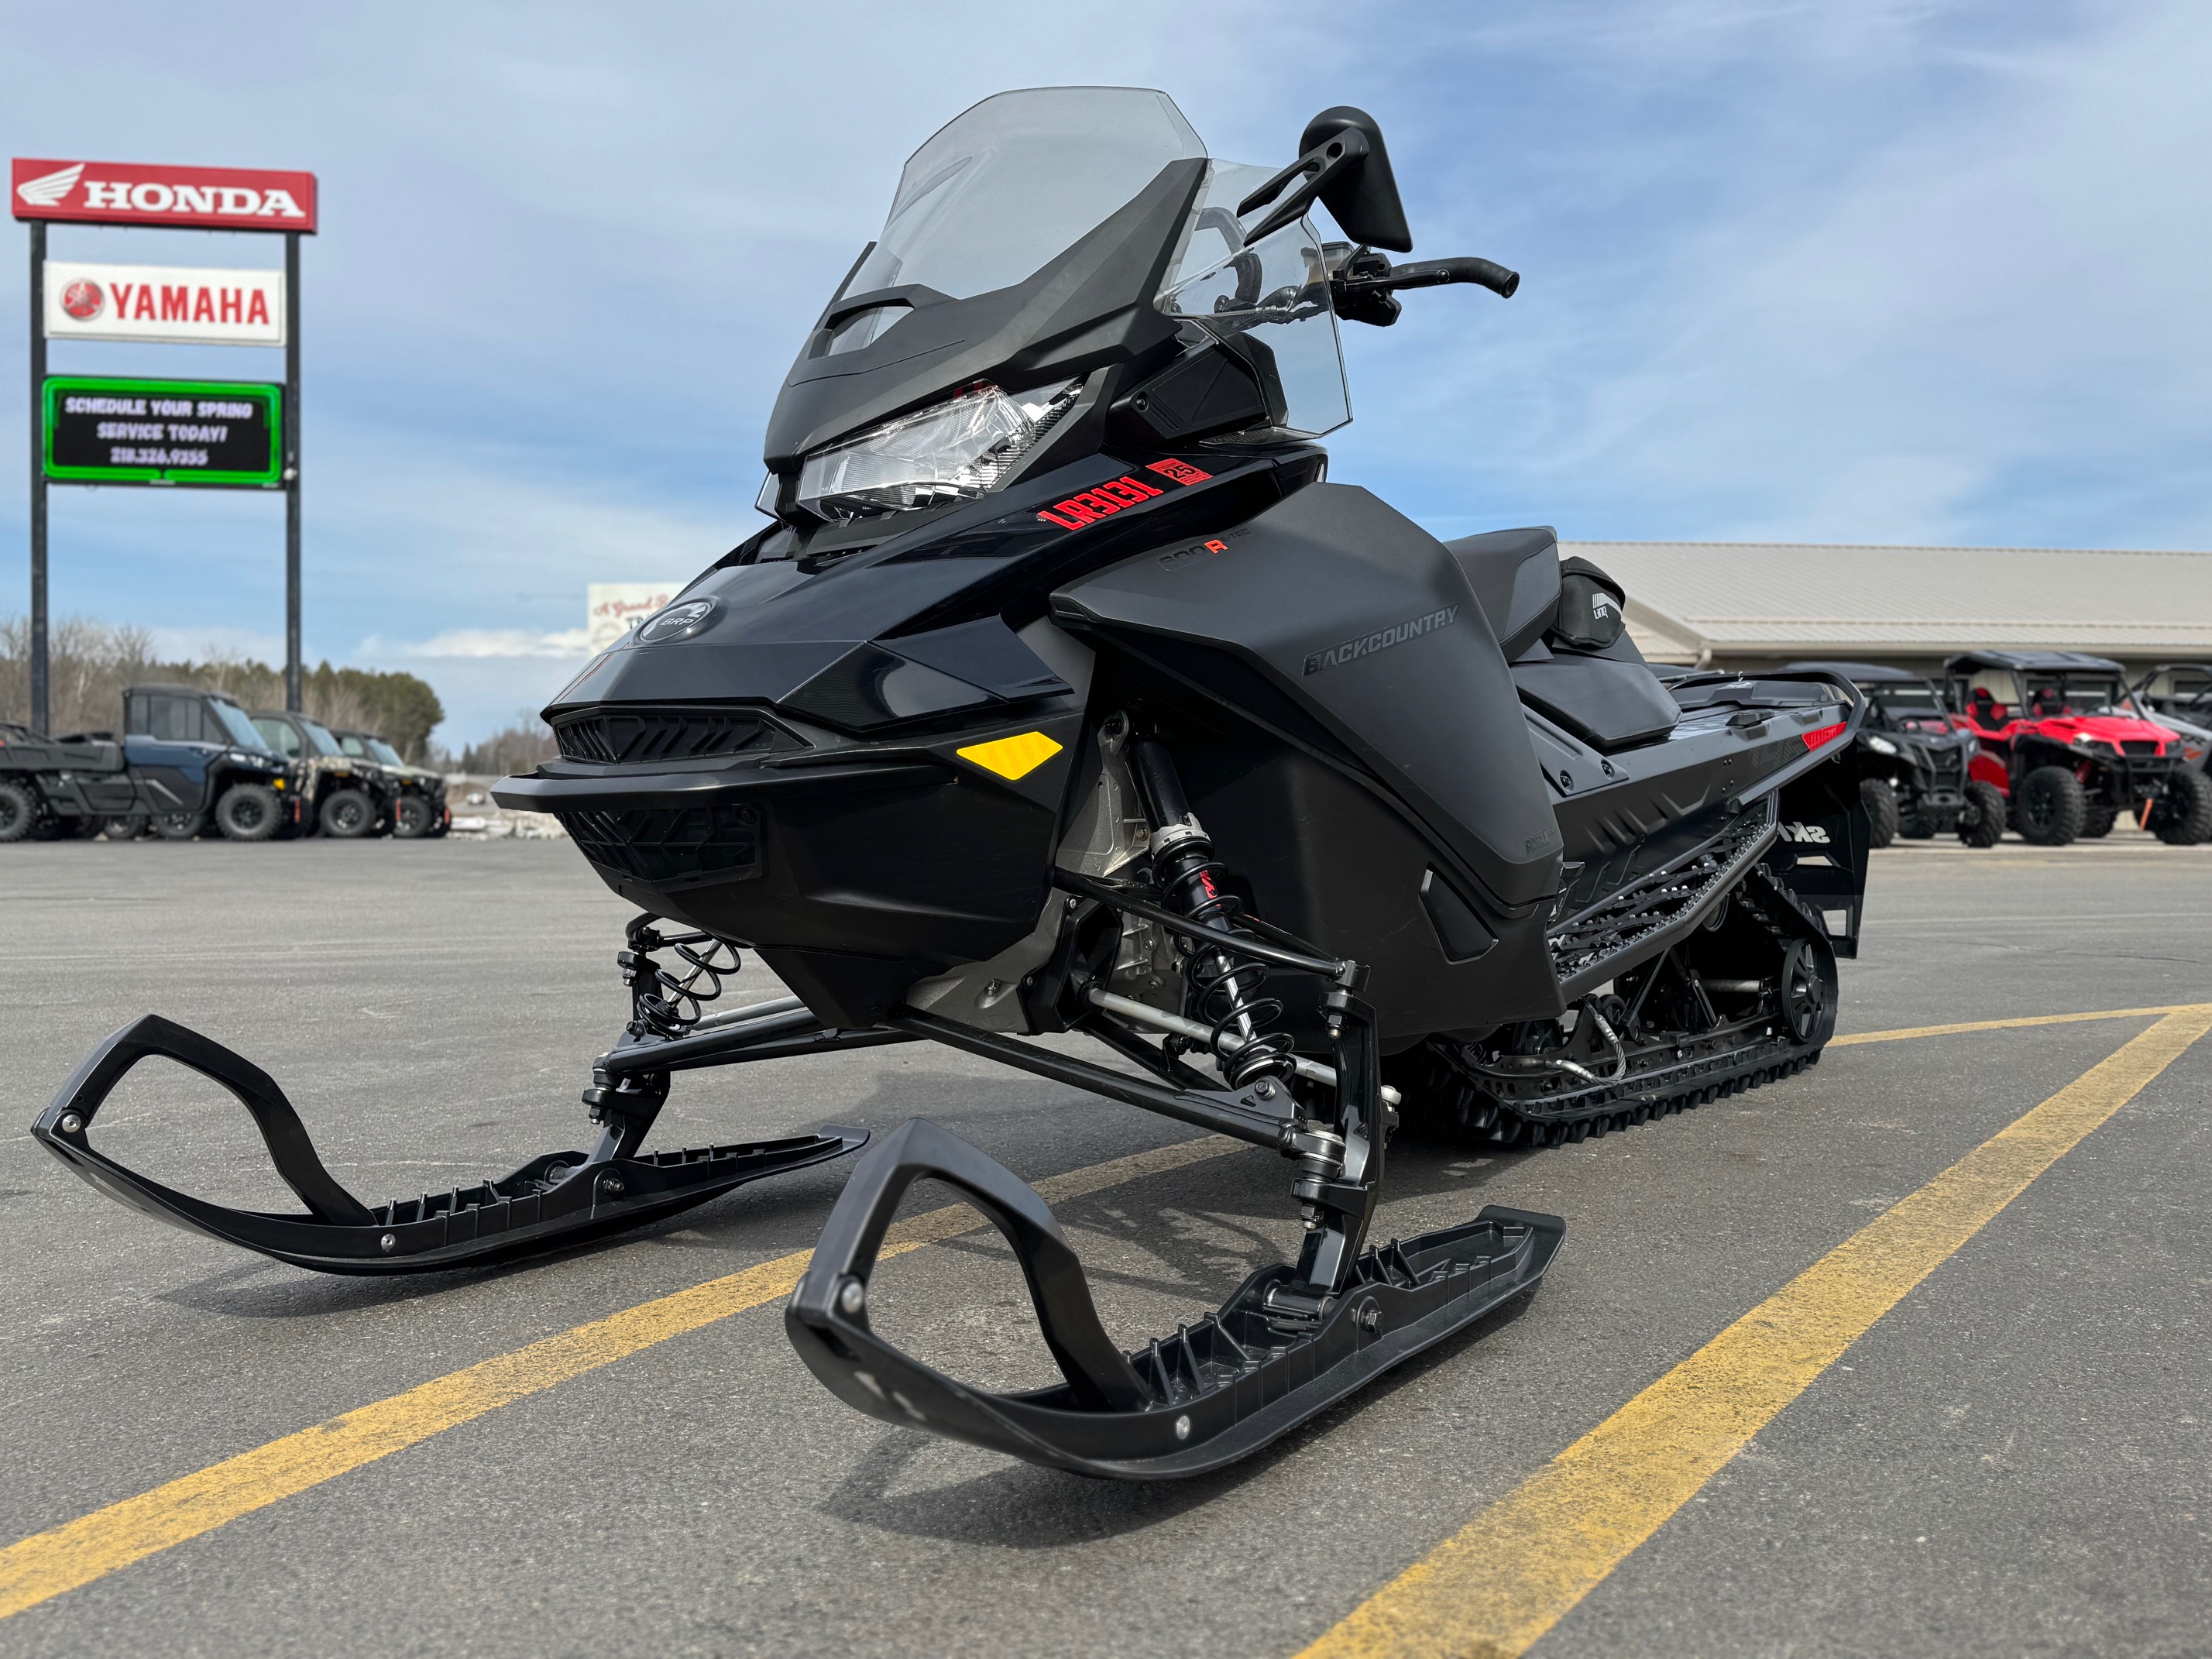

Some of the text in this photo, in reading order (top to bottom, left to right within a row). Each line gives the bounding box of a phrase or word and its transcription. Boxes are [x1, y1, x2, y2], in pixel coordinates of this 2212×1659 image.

[84, 180, 306, 218] HONDA
[110, 283, 270, 325] YAMAHA
[65, 397, 253, 419] SCHEDULE YOUR SPRING
[97, 422, 228, 443] SERVICE TODAY!
[1163, 465, 1196, 479] 25
[1036, 476, 1164, 531] LR3131
[660, 617, 695, 626] BRP
[1303, 604, 1460, 676] BACKCOUNTRY
